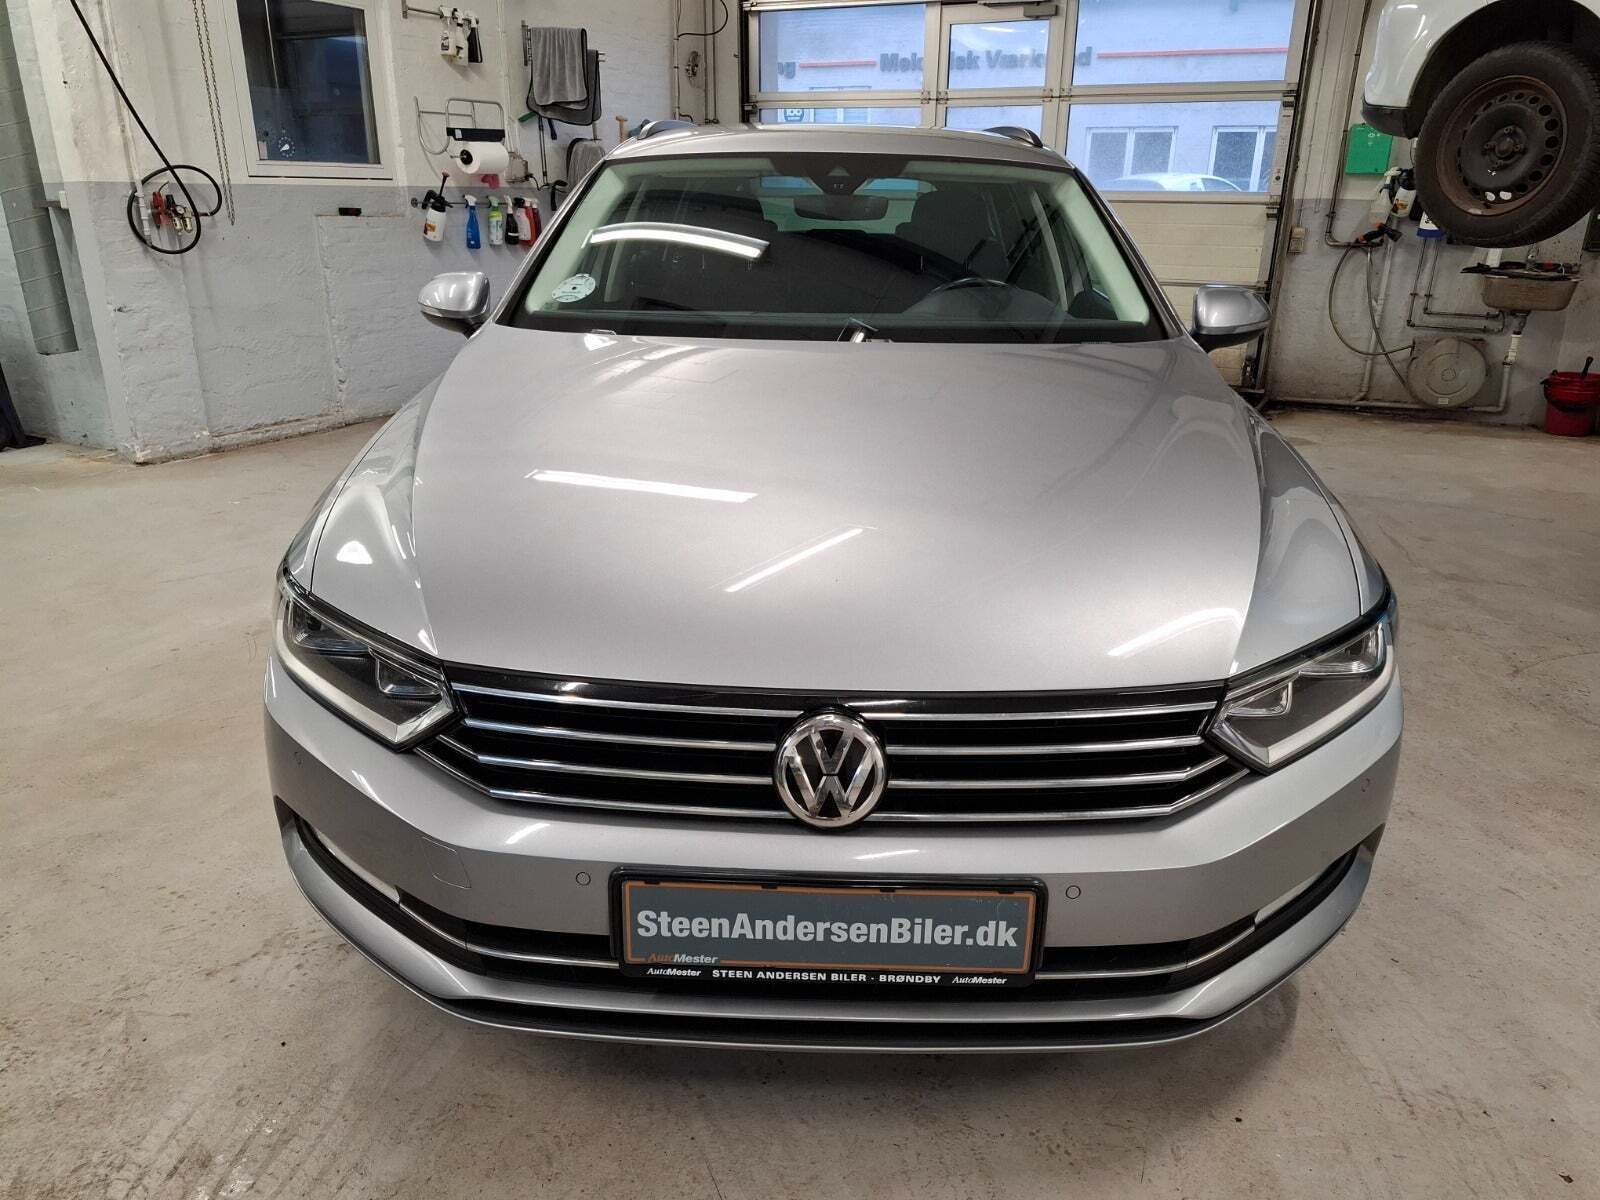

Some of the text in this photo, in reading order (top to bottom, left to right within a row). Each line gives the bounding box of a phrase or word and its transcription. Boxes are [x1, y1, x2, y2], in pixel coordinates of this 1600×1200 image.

[637, 910, 1017, 947] SteenAndersenBiler.dk
[648, 953, 719, 964] AutoMester
[647, 967, 702, 977] AutoMester
[712, 969, 941, 984] STEEN ANDERSEN BILER BRØNDBY
[952, 976, 1007, 985] AutoMester
